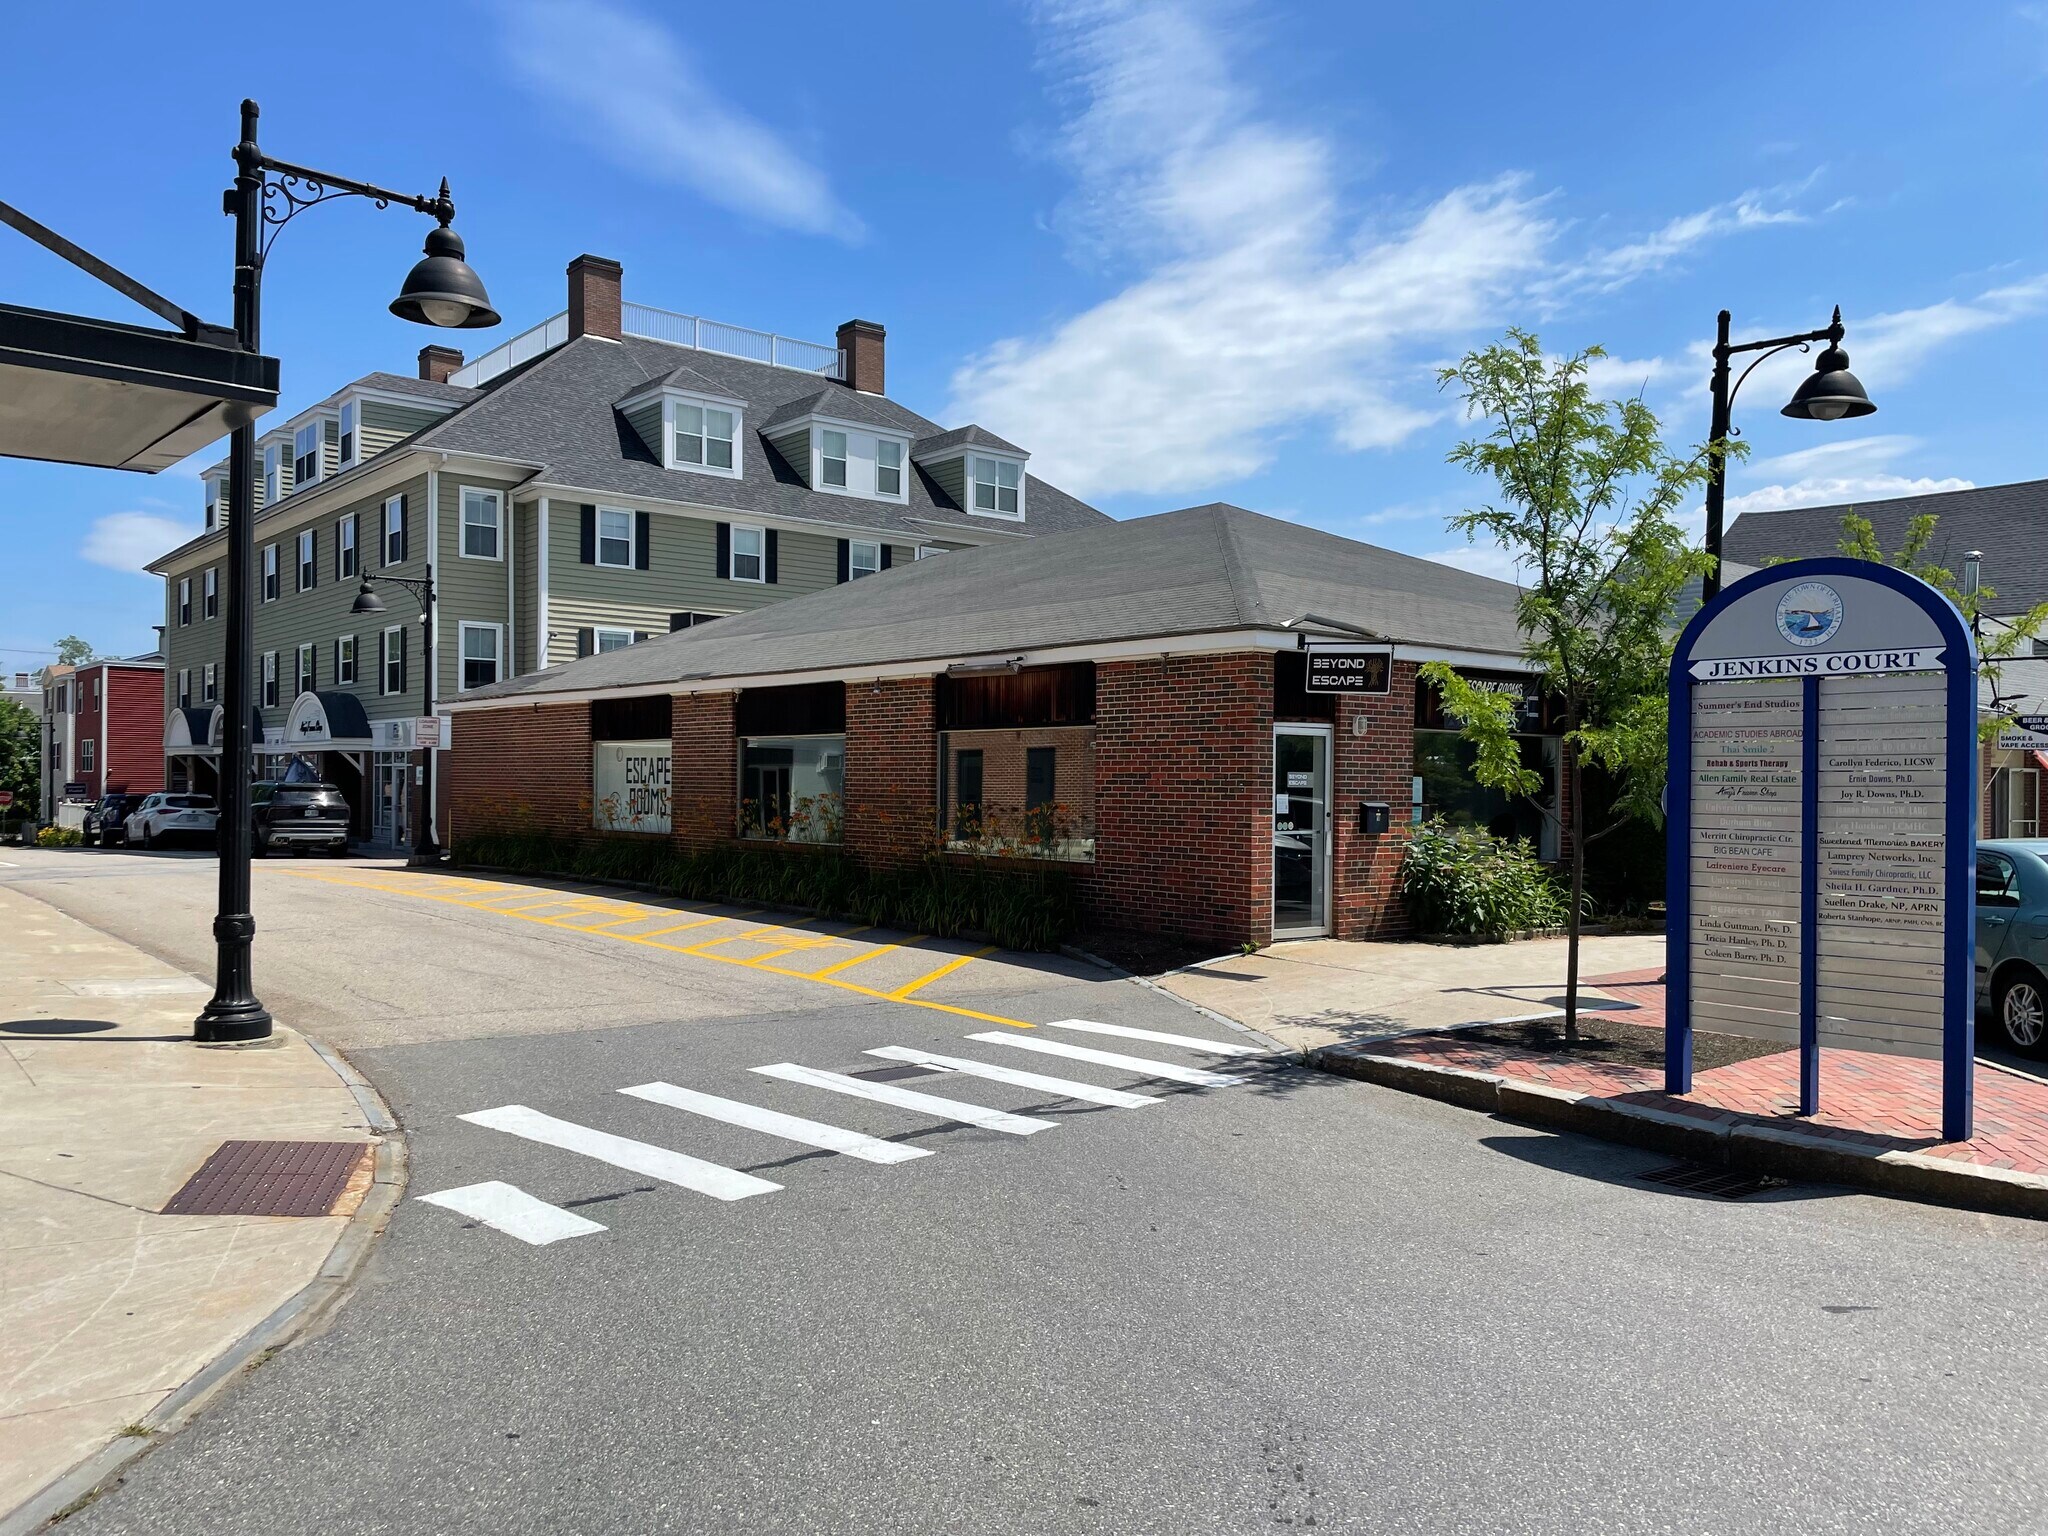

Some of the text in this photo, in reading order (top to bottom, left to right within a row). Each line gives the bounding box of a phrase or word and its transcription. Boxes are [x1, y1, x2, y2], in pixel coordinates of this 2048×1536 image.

[1780, 593, 1792, 607] THE
[1793, 583, 1816, 595] TOWN
[1817, 584, 1826, 592] OF
[1826, 590, 1842, 623] DURHAM
[1313, 658, 1366, 669] BEYOND
[1709, 651, 1921, 677] JENKINS COURT
[1312, 675, 1364, 686] ESCAPE
[1698, 699, 1800, 710] Summer's End Studios
[1735, 730, 1769, 738] STUDIES
[1769, 729, 1803, 738] ABROAD
[1720, 746, 1739, 754] Thai
[1742, 746, 1768, 754] Smile
[1735, 760, 1759, 768] Sports
[1760, 760, 1789, 768] Therapy
[1829, 758, 1936, 768] Carollyn Federico, LICSW
[626, 757, 671, 785] ESCAPE
[1722, 775, 1748, 783] Family
[1771, 775, 1797, 783] Estate
[1848, 775, 1915, 783] Ernie Downs, Ph.D.
[1841, 790, 1925, 799] Joy R. Downs, Ph.D.
[629, 787, 668, 816] ROOMS
[1700, 832, 1794, 843] Merritt Chiropractic Ctr.
[1819, 837, 1945, 848] Sweetened Memories BAKERY
[1714, 846, 1773, 856] BIG BEAN CAFE
[1827, 851, 1937, 863] Lamprey Networks, Inc.
[1706, 861, 1787, 873] Lafreniere Eyecare
[1851, 868, 1874, 878] Family
[1875, 869, 1917, 880] Chiropractic,
[1918, 871, 1932, 879] LLC
[1825, 882, 1939, 895] Sheila H. Gardner, Ph.D.
[1824, 899, 1939, 912] Suellen Drake, NP, APRN
[1710, 905, 1780, 918] PERFECT TAN
[1818, 913, 1846, 921] Roberta
[1847, 914, 1883, 924] Stanhope,
[1699, 919, 1793, 934] Linda Guttman, Psy. D.
[1704, 933, 1787, 949] Tricia Hanley, Ph. D.
[1704, 949, 1787, 964] Coleen Barry, Ph. D.
